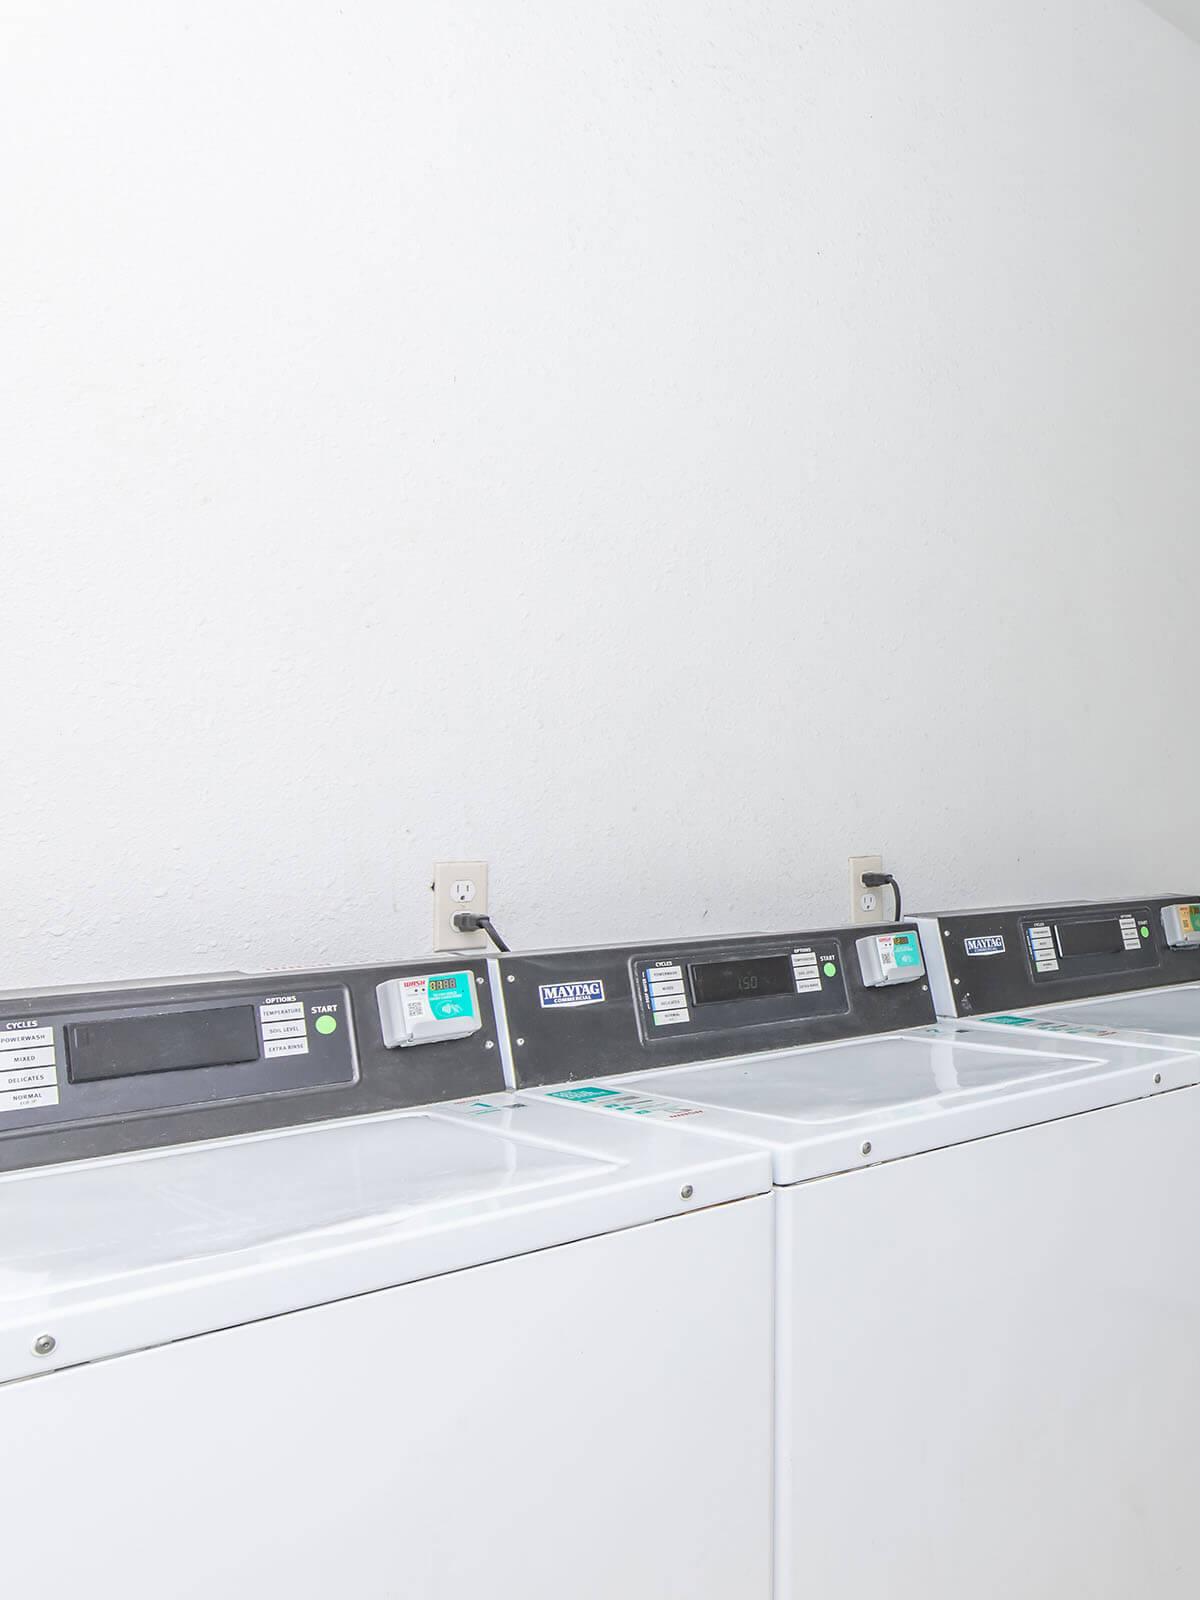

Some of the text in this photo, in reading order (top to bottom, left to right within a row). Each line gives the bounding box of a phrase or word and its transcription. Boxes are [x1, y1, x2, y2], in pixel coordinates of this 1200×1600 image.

[968, 938, 1002, 950] MAYTAG
[544, 983, 600, 1000] MAYTAG
[265, 995, 297, 1004] OPTIONS
[263, 1007, 301, 1017] TEMPERATURE
[311, 1004, 338, 1014] START
[6, 1020, 39, 1030] CYCLES
[0, 1034, 46, 1044] POWERWASH
[269, 1045, 287, 1053] EXTRA
[13, 1055, 36, 1063] MIXED
[8, 1075, 45, 1084] DELICATES
[13, 1093, 42, 1101] NORMAL
